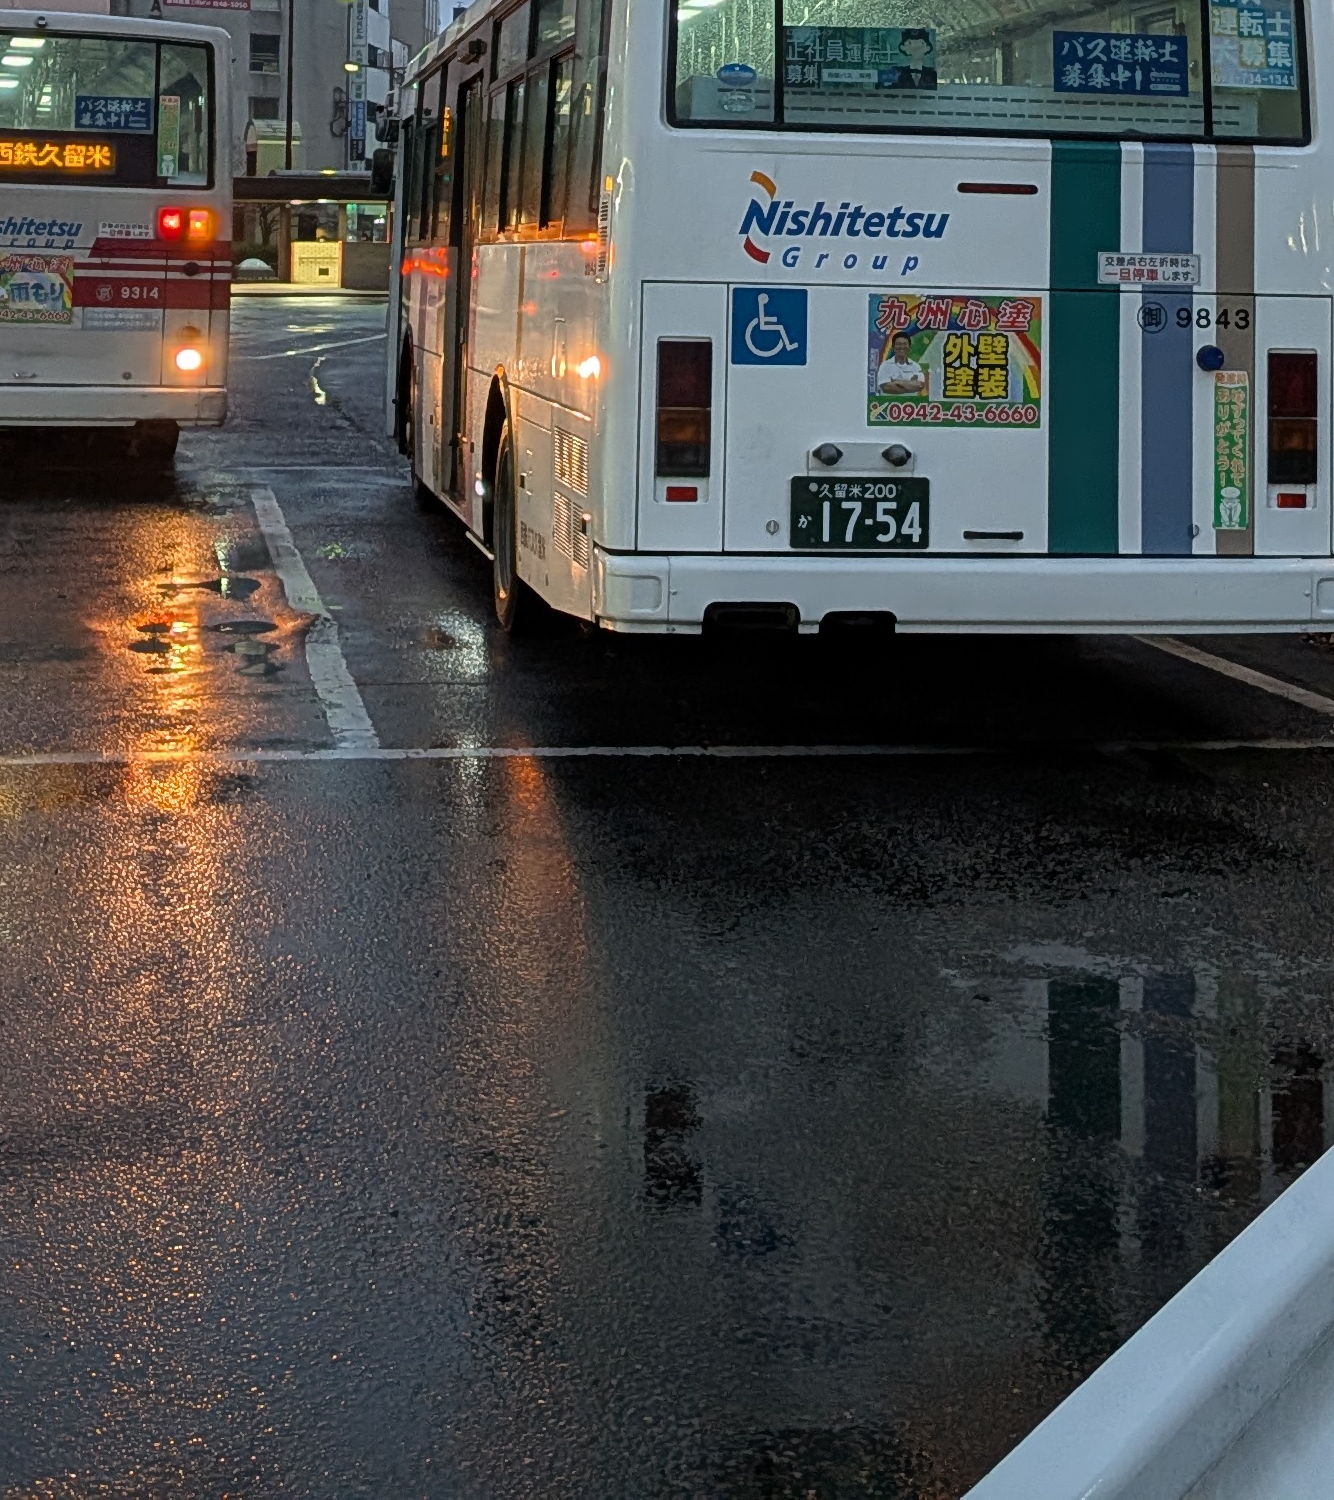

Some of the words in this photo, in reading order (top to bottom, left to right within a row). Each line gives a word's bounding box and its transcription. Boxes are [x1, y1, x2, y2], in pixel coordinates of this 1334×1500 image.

[1212, 9, 1290, 37] 運転士
[785, 39, 899, 64] 正社員運転士
[1061, 38, 1179, 63] バス運転士
[786, 64, 819, 84] 募集
[1061, 62, 1131, 90] 募集中
[739, 198, 951, 239] Nishitetsu
[781, 246, 919, 276] Group
[1105, 256, 1196, 269] 交差点右左折時は、
[1105, 268, 1196, 282] 一旦停車します。
[9, 281, 65, 303] 雨もり
[120, 287, 160, 299] 9314
[875, 297, 1035, 330] 九州心塗
[1176, 307, 1250, 330] 9843
[944, 333, 1009, 365] 外壁
[944, 366, 1009, 398] 塗装
[887, 403, 1038, 423] 0942-43-6660
[819, 483, 897, 499] 久留米200
[798, 514, 813, 529] か
[822, 501, 922, 543] 17-54
